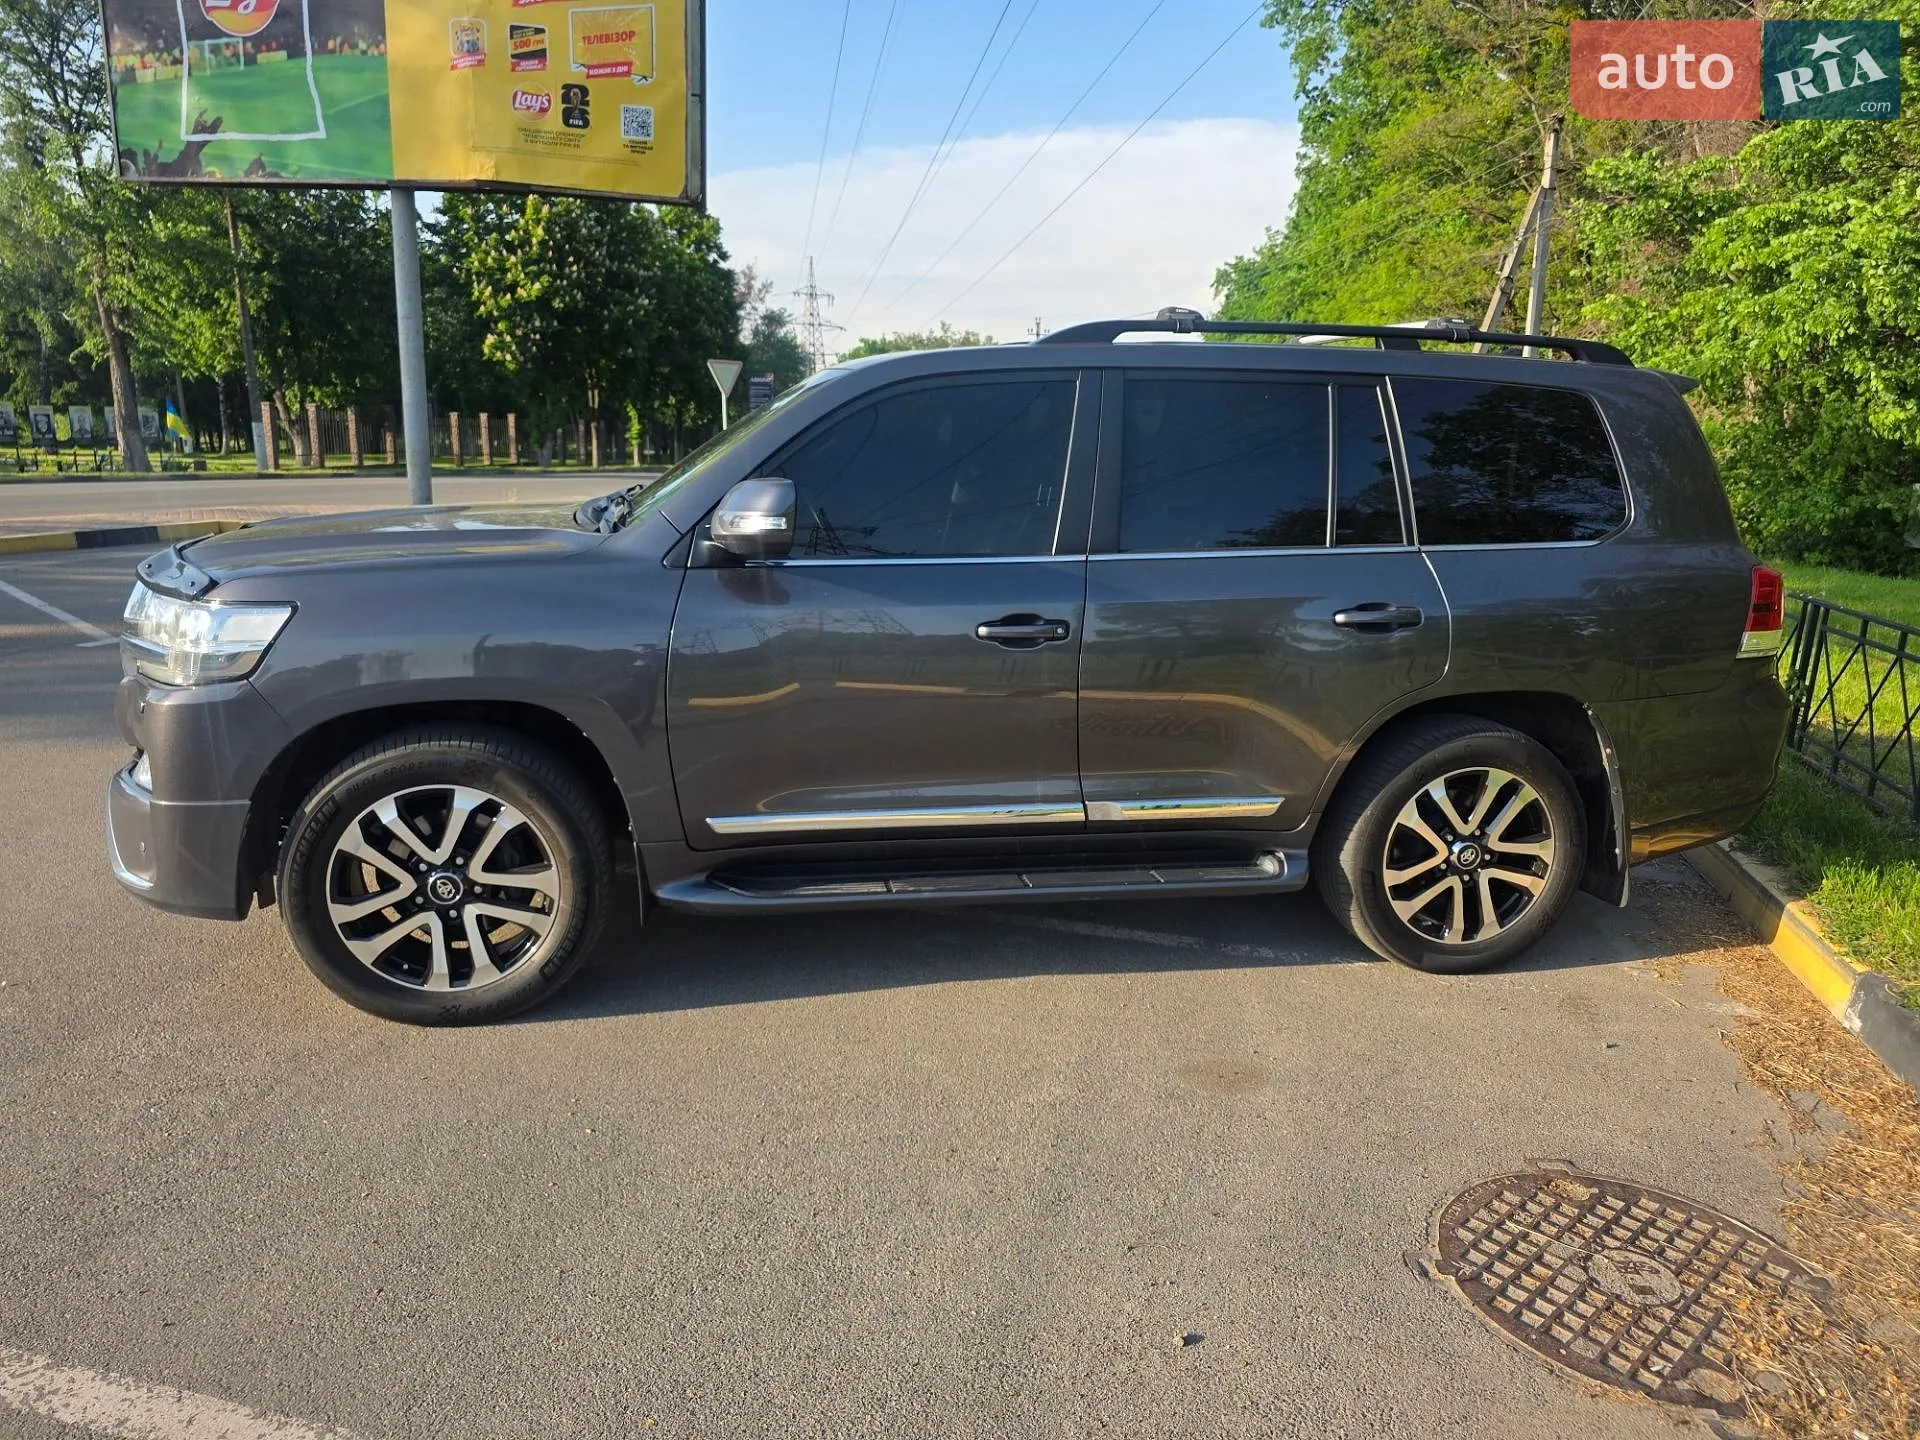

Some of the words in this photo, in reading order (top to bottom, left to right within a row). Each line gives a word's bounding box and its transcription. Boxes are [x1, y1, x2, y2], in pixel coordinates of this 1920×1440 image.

[513, 39, 531, 50] 500
[582, 30, 636, 45] ТЕЛЕВІЗОР
[515, 91, 549, 112] Lay's
[384, 761, 424, 777] SPORT
